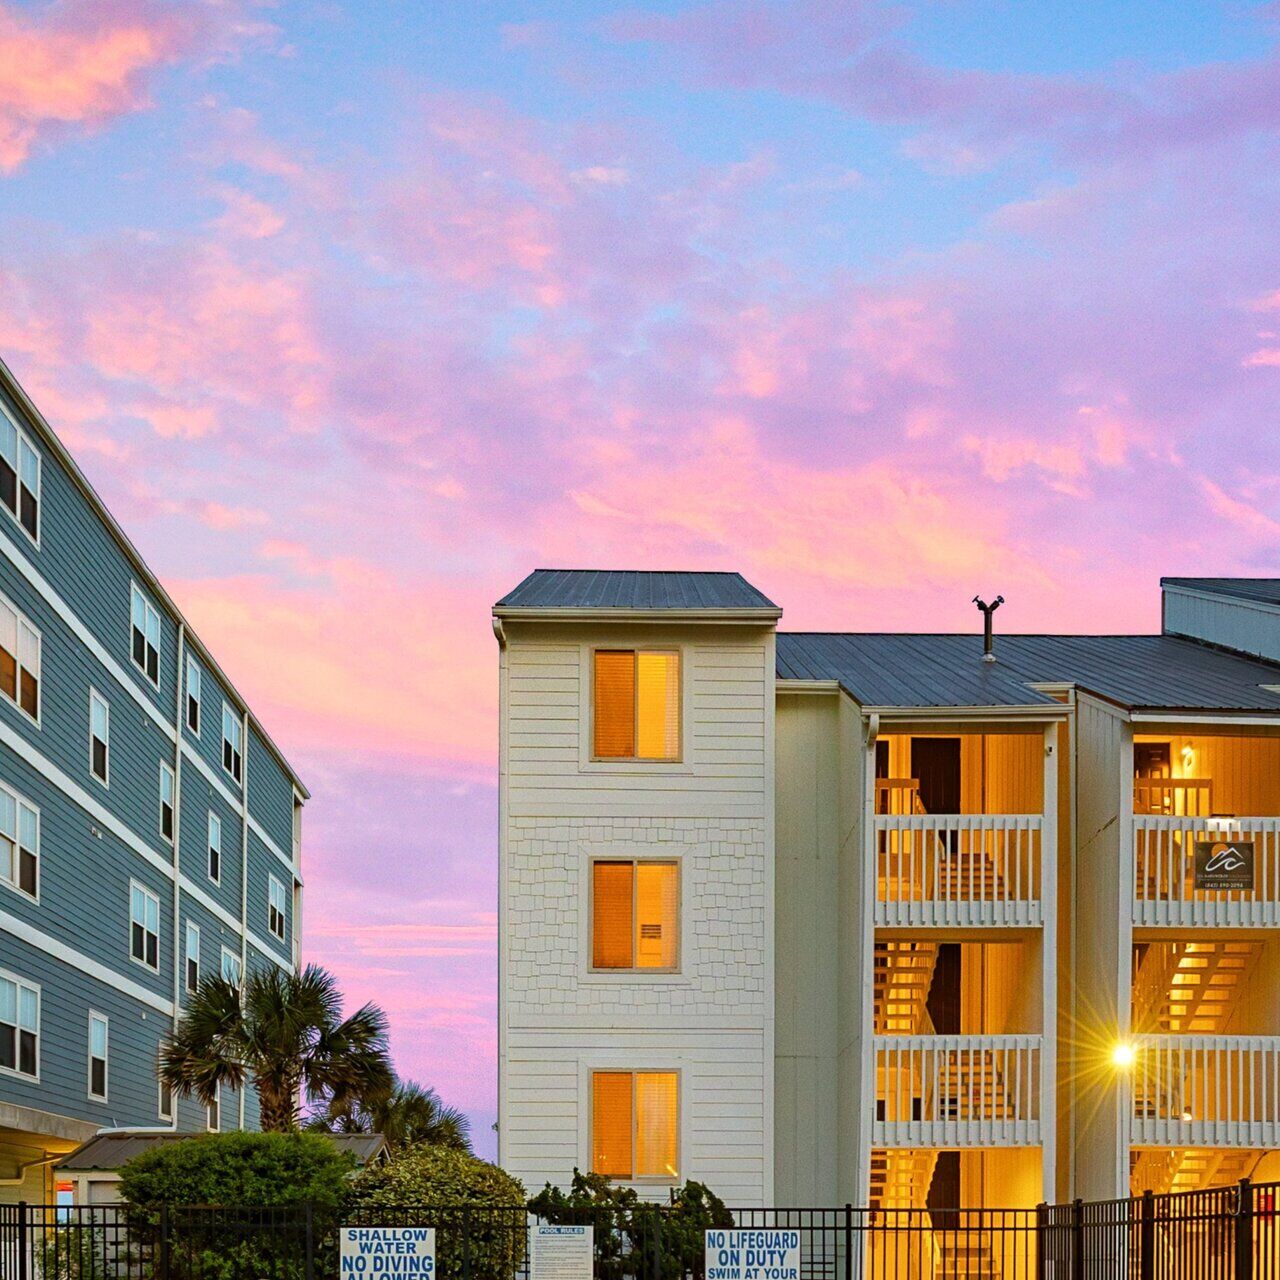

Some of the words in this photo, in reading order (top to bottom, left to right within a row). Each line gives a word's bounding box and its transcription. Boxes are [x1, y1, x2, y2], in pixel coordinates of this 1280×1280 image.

[348, 1230, 427, 1241] SHALLOW
[707, 1232, 725, 1249] NO
[729, 1232, 798, 1249] LIFEGUARD
[359, 1242, 417, 1254] WATER
[342, 1256, 367, 1272] NO
[373, 1256, 433, 1272] DIVING
[718, 1250, 740, 1267] ON
[746, 1250, 787, 1267] DUTY
[708, 1268, 740, 1279] SWIM
[744, 1268, 760, 1280] AT
[764, 1268, 797, 1280] YOUR
